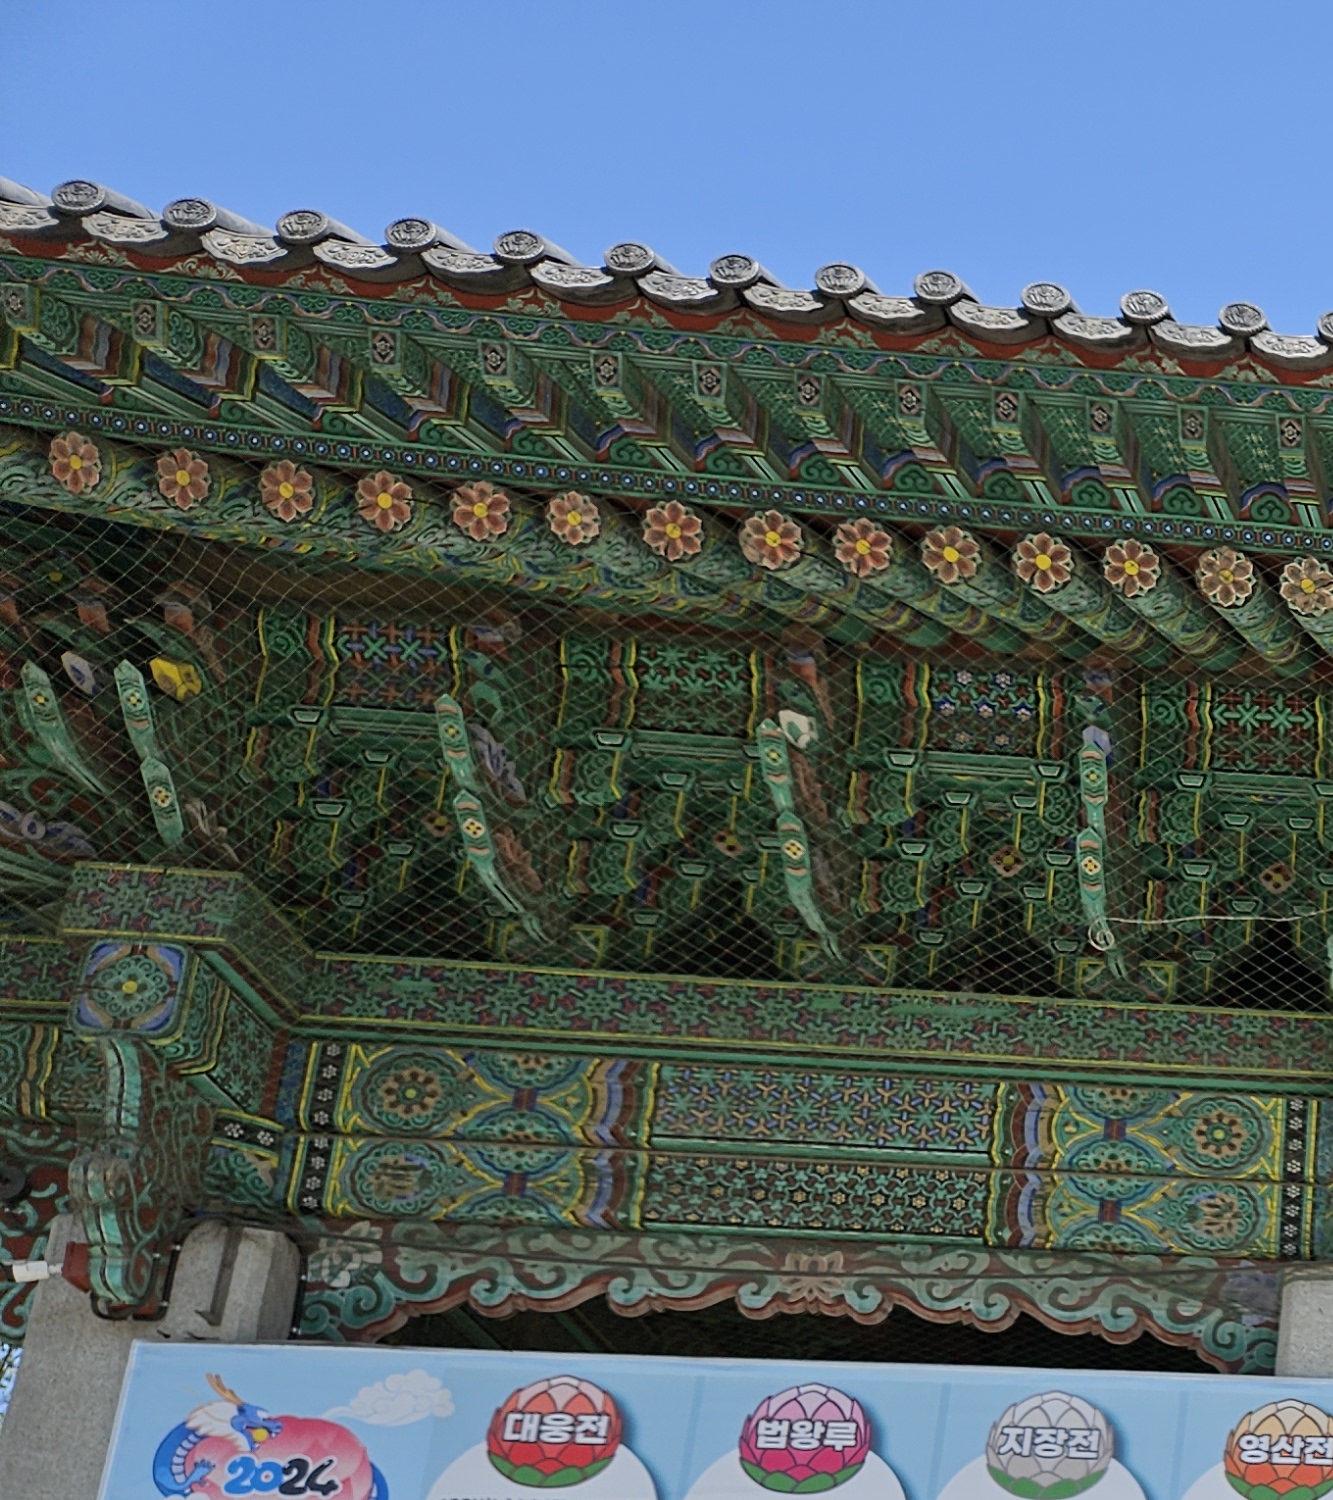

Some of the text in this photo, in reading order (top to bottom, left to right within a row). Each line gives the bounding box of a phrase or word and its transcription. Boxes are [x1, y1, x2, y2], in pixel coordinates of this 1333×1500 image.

[504, 1412, 611, 1445] 대웅전
[756, 1419, 858, 1451] 법왕루
[999, 1424, 1102, 1461] 지장전
[224, 1456, 340, 1497] 2024
